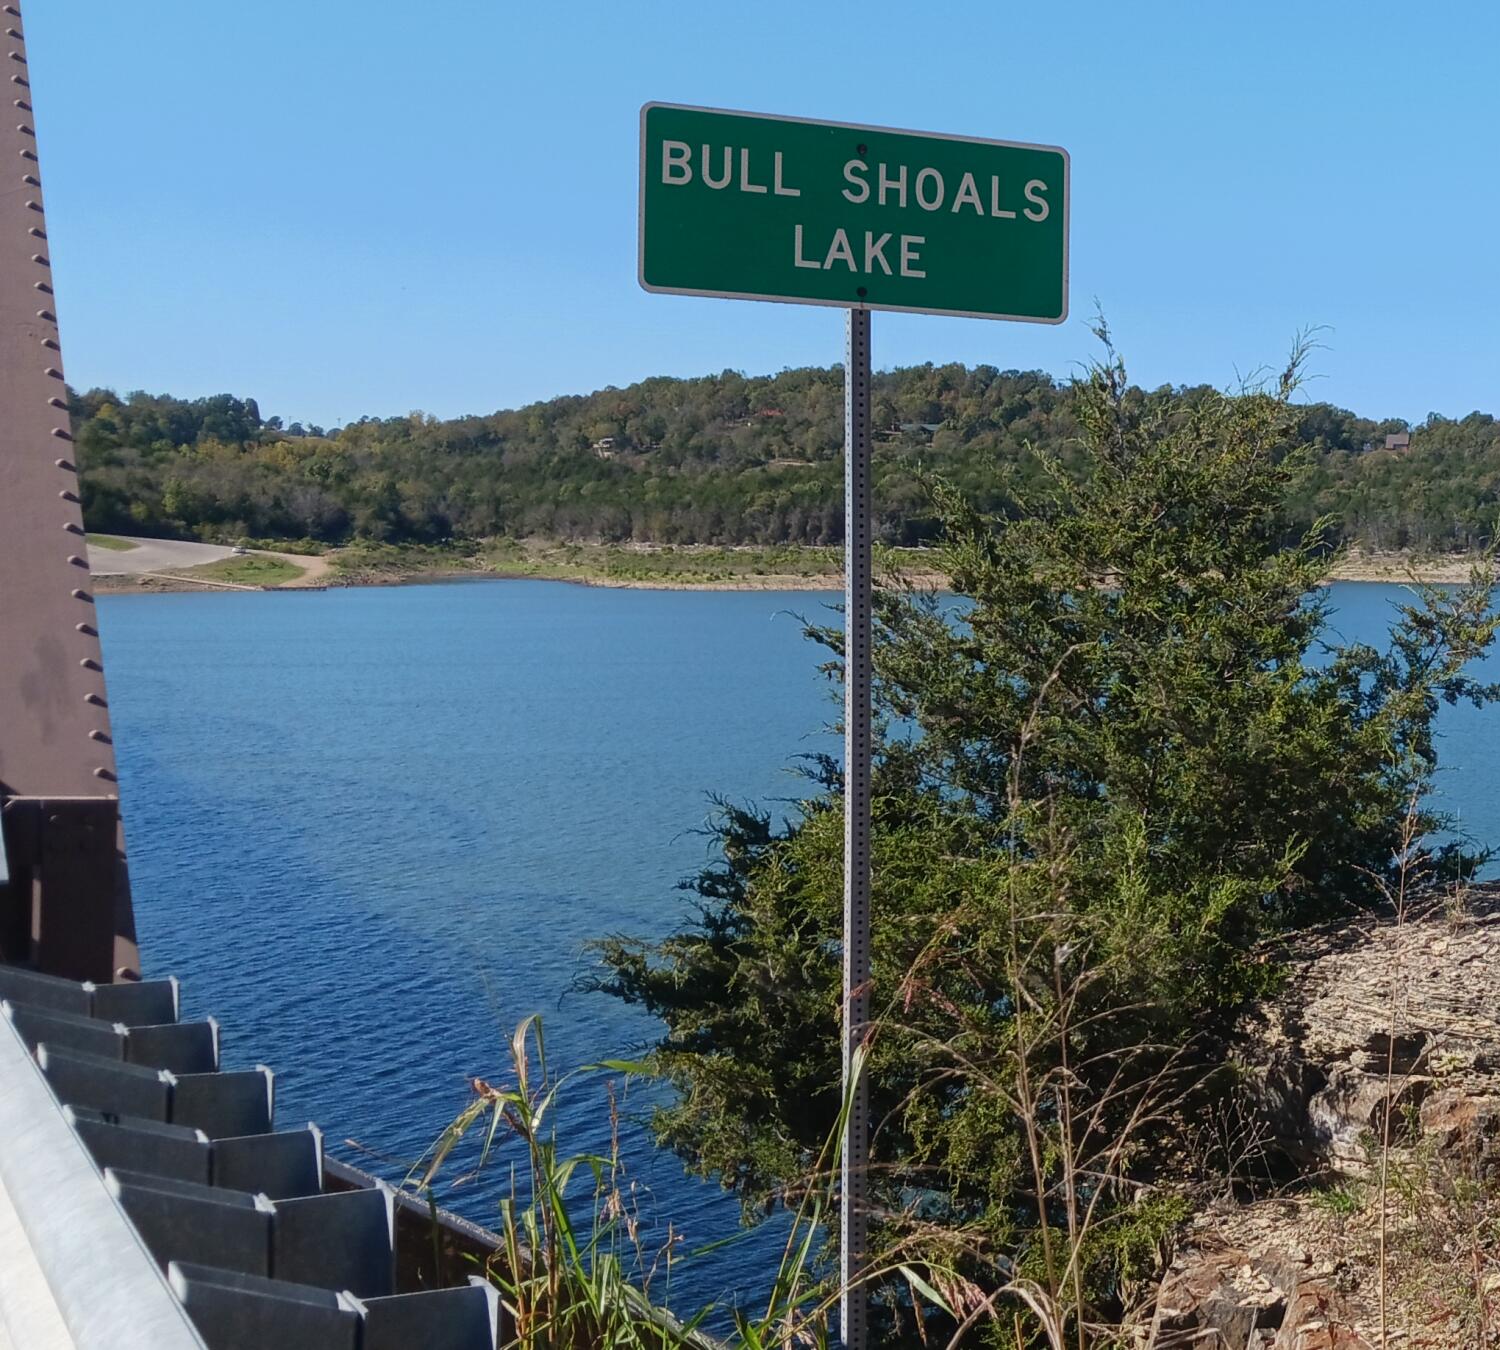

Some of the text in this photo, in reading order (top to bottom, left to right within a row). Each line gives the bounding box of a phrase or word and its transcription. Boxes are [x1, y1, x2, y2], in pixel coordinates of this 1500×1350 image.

[661, 140, 1050, 222] BULL SHOALS
[794, 224, 926, 279] LAKE
